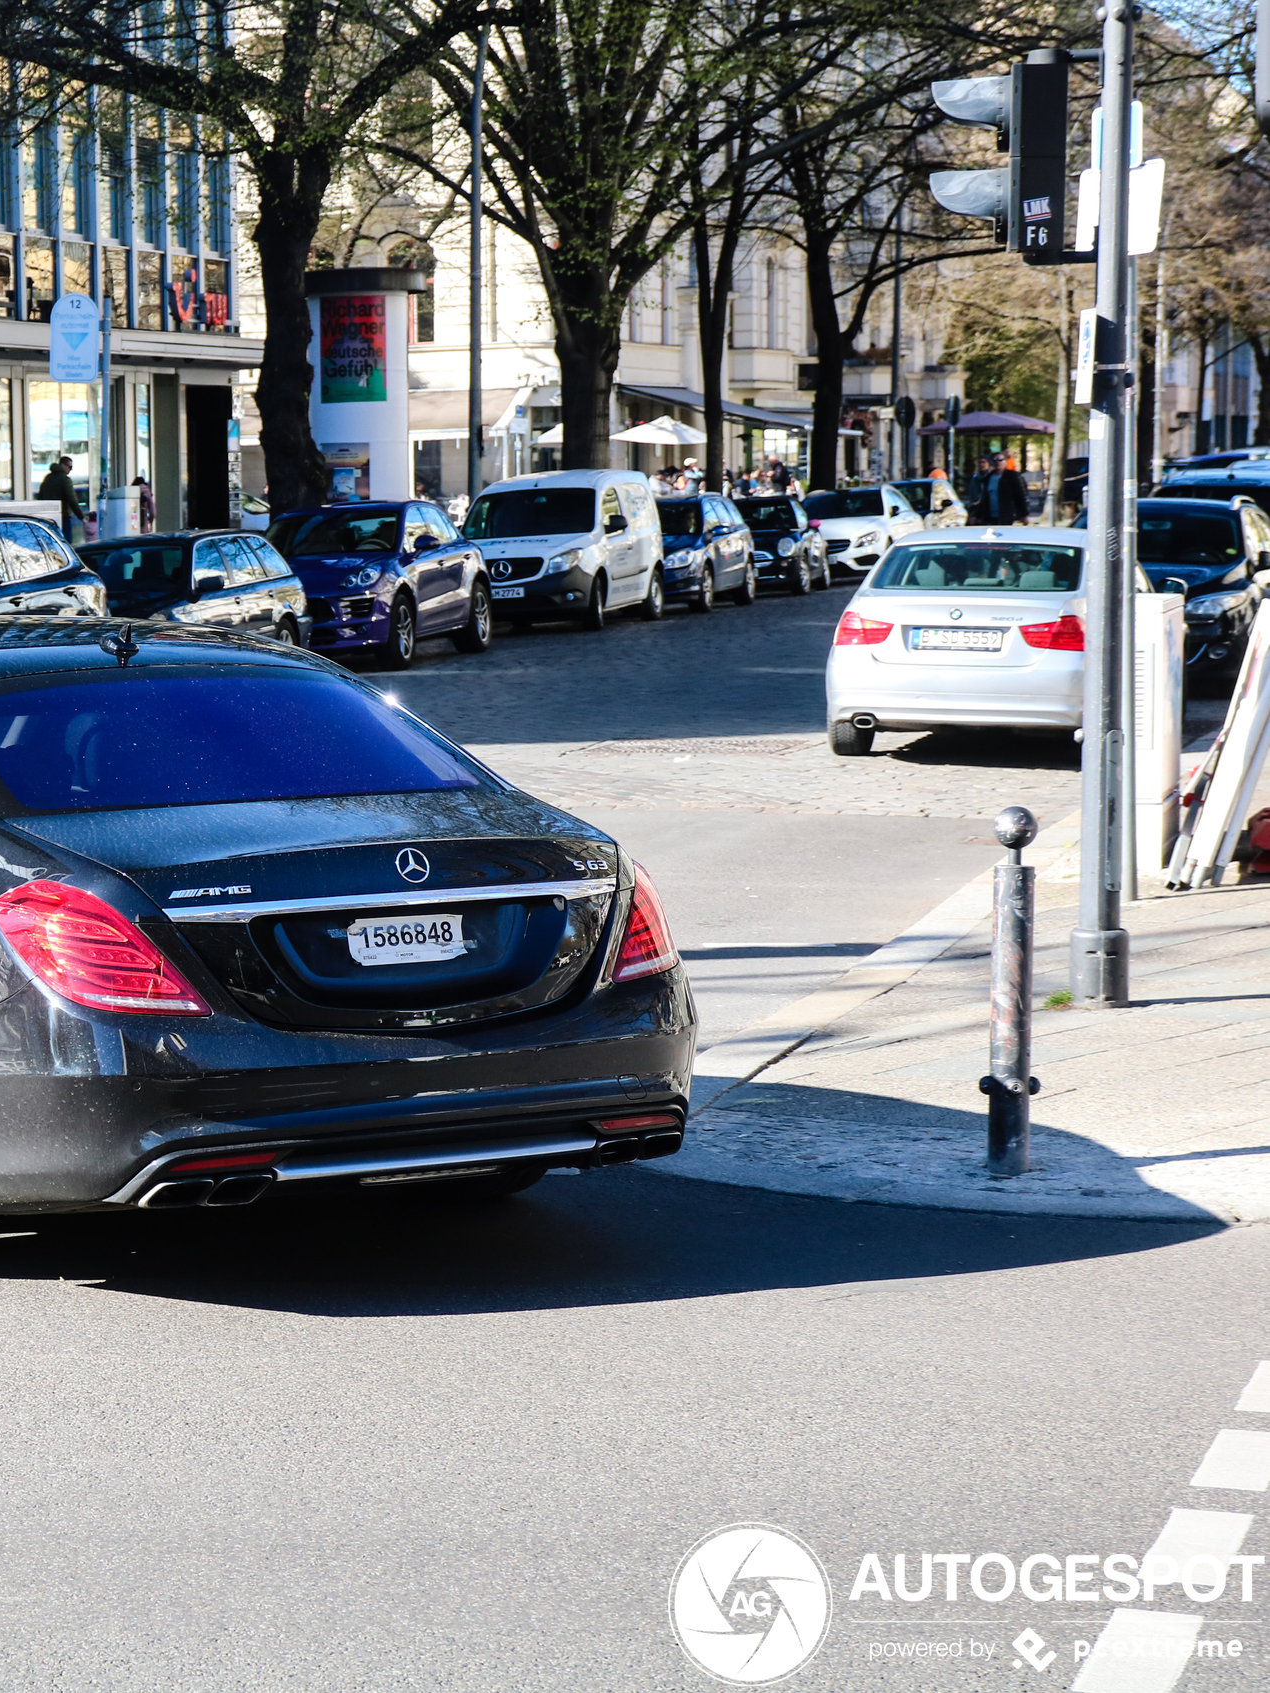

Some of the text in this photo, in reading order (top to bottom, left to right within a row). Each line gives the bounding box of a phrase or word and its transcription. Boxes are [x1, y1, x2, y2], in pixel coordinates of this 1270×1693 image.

[1023, 199, 1051, 217] LMK
[69, 299, 82, 309] 12
[321, 299, 386, 318] Richard
[60, 321, 90, 330] automat
[321, 319, 386, 340] Wagner
[324, 344, 383, 359] deutsche
[56, 361, 92, 371] Parkschein
[324, 359, 379, 378] Gefühl
[65, 370, 83, 378] lösen
[500, 588, 521, 597] 2774
[921, 630, 999, 645] B SD 5559
[195, 885, 252, 897] AMG
[360, 921, 453, 948] 1586848
